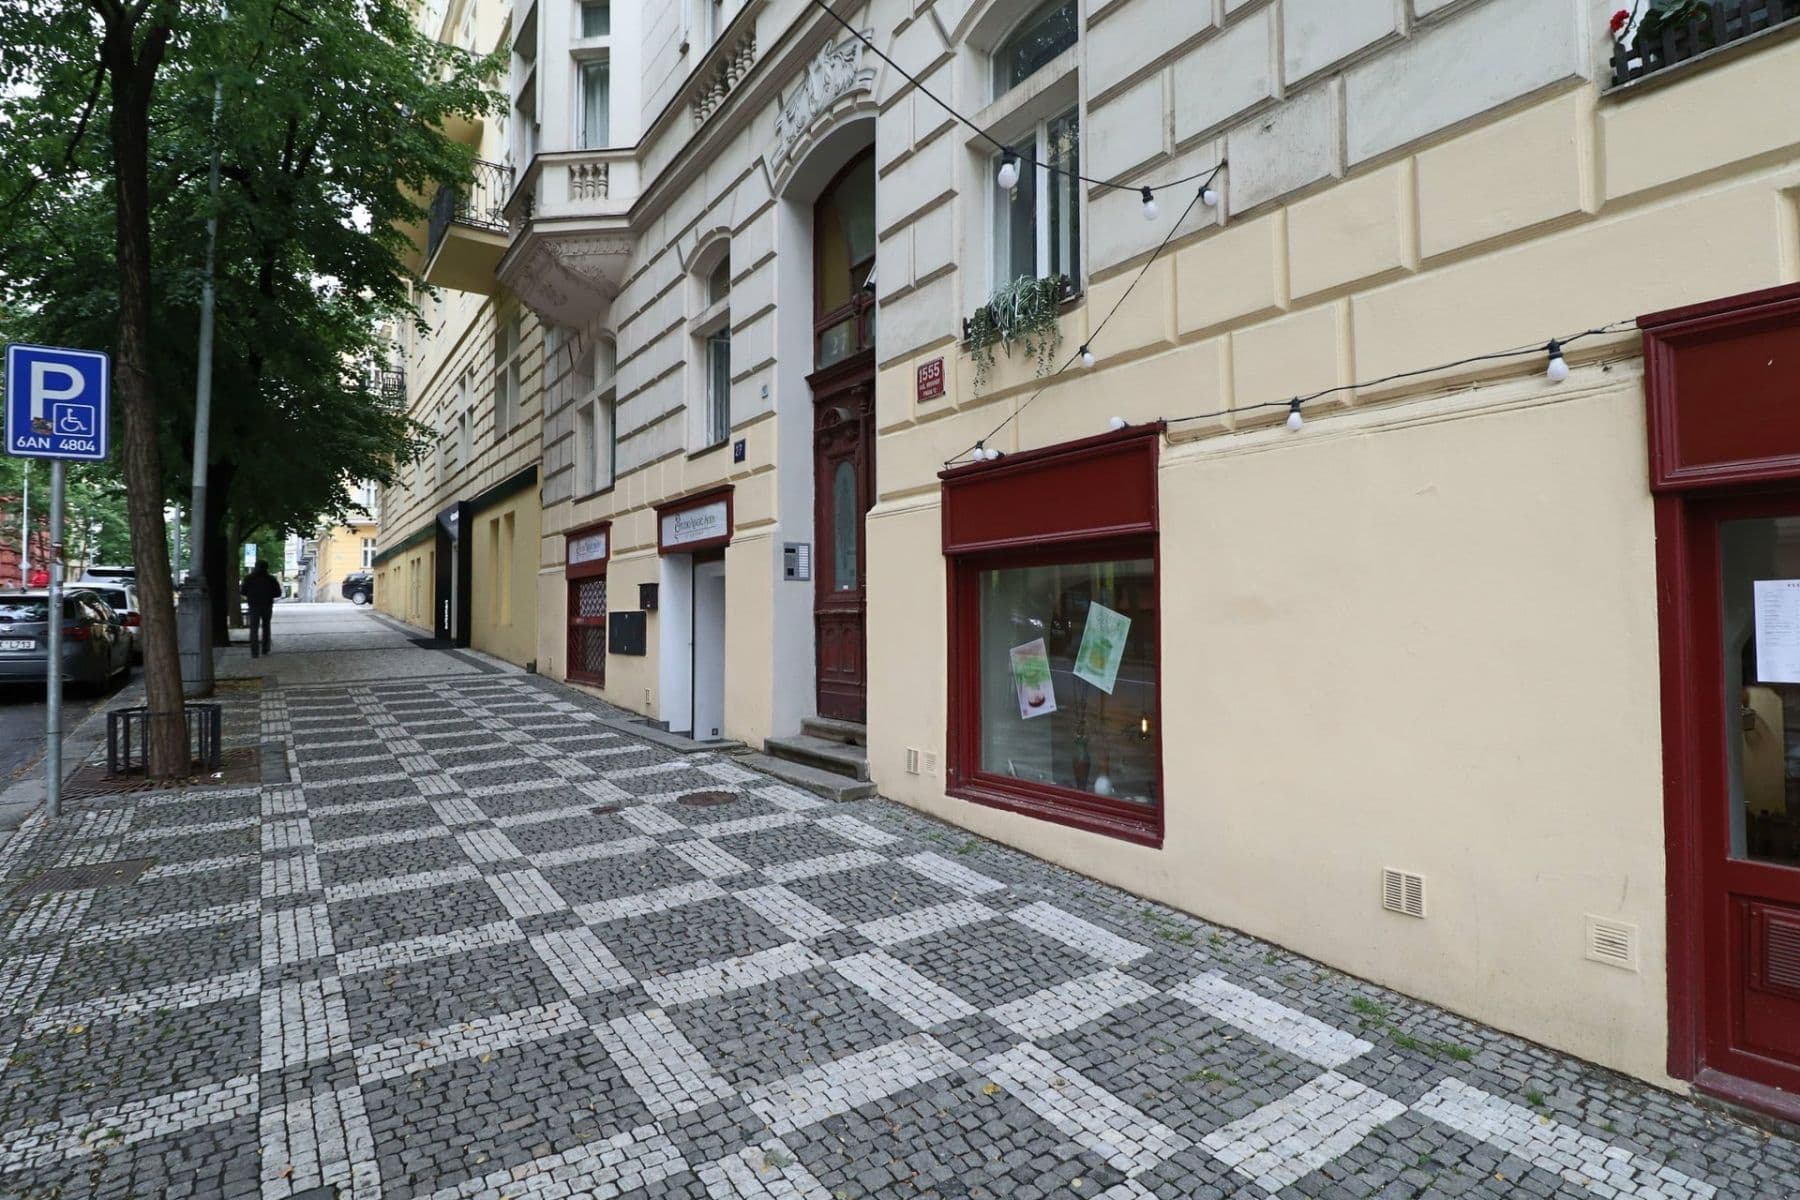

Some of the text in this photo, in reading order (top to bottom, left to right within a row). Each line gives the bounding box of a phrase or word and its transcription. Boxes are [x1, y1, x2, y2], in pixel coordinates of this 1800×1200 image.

[919, 362, 940, 383] 1555
[30, 361, 85, 421] P
[17, 436, 96, 452] 6AN 4804
